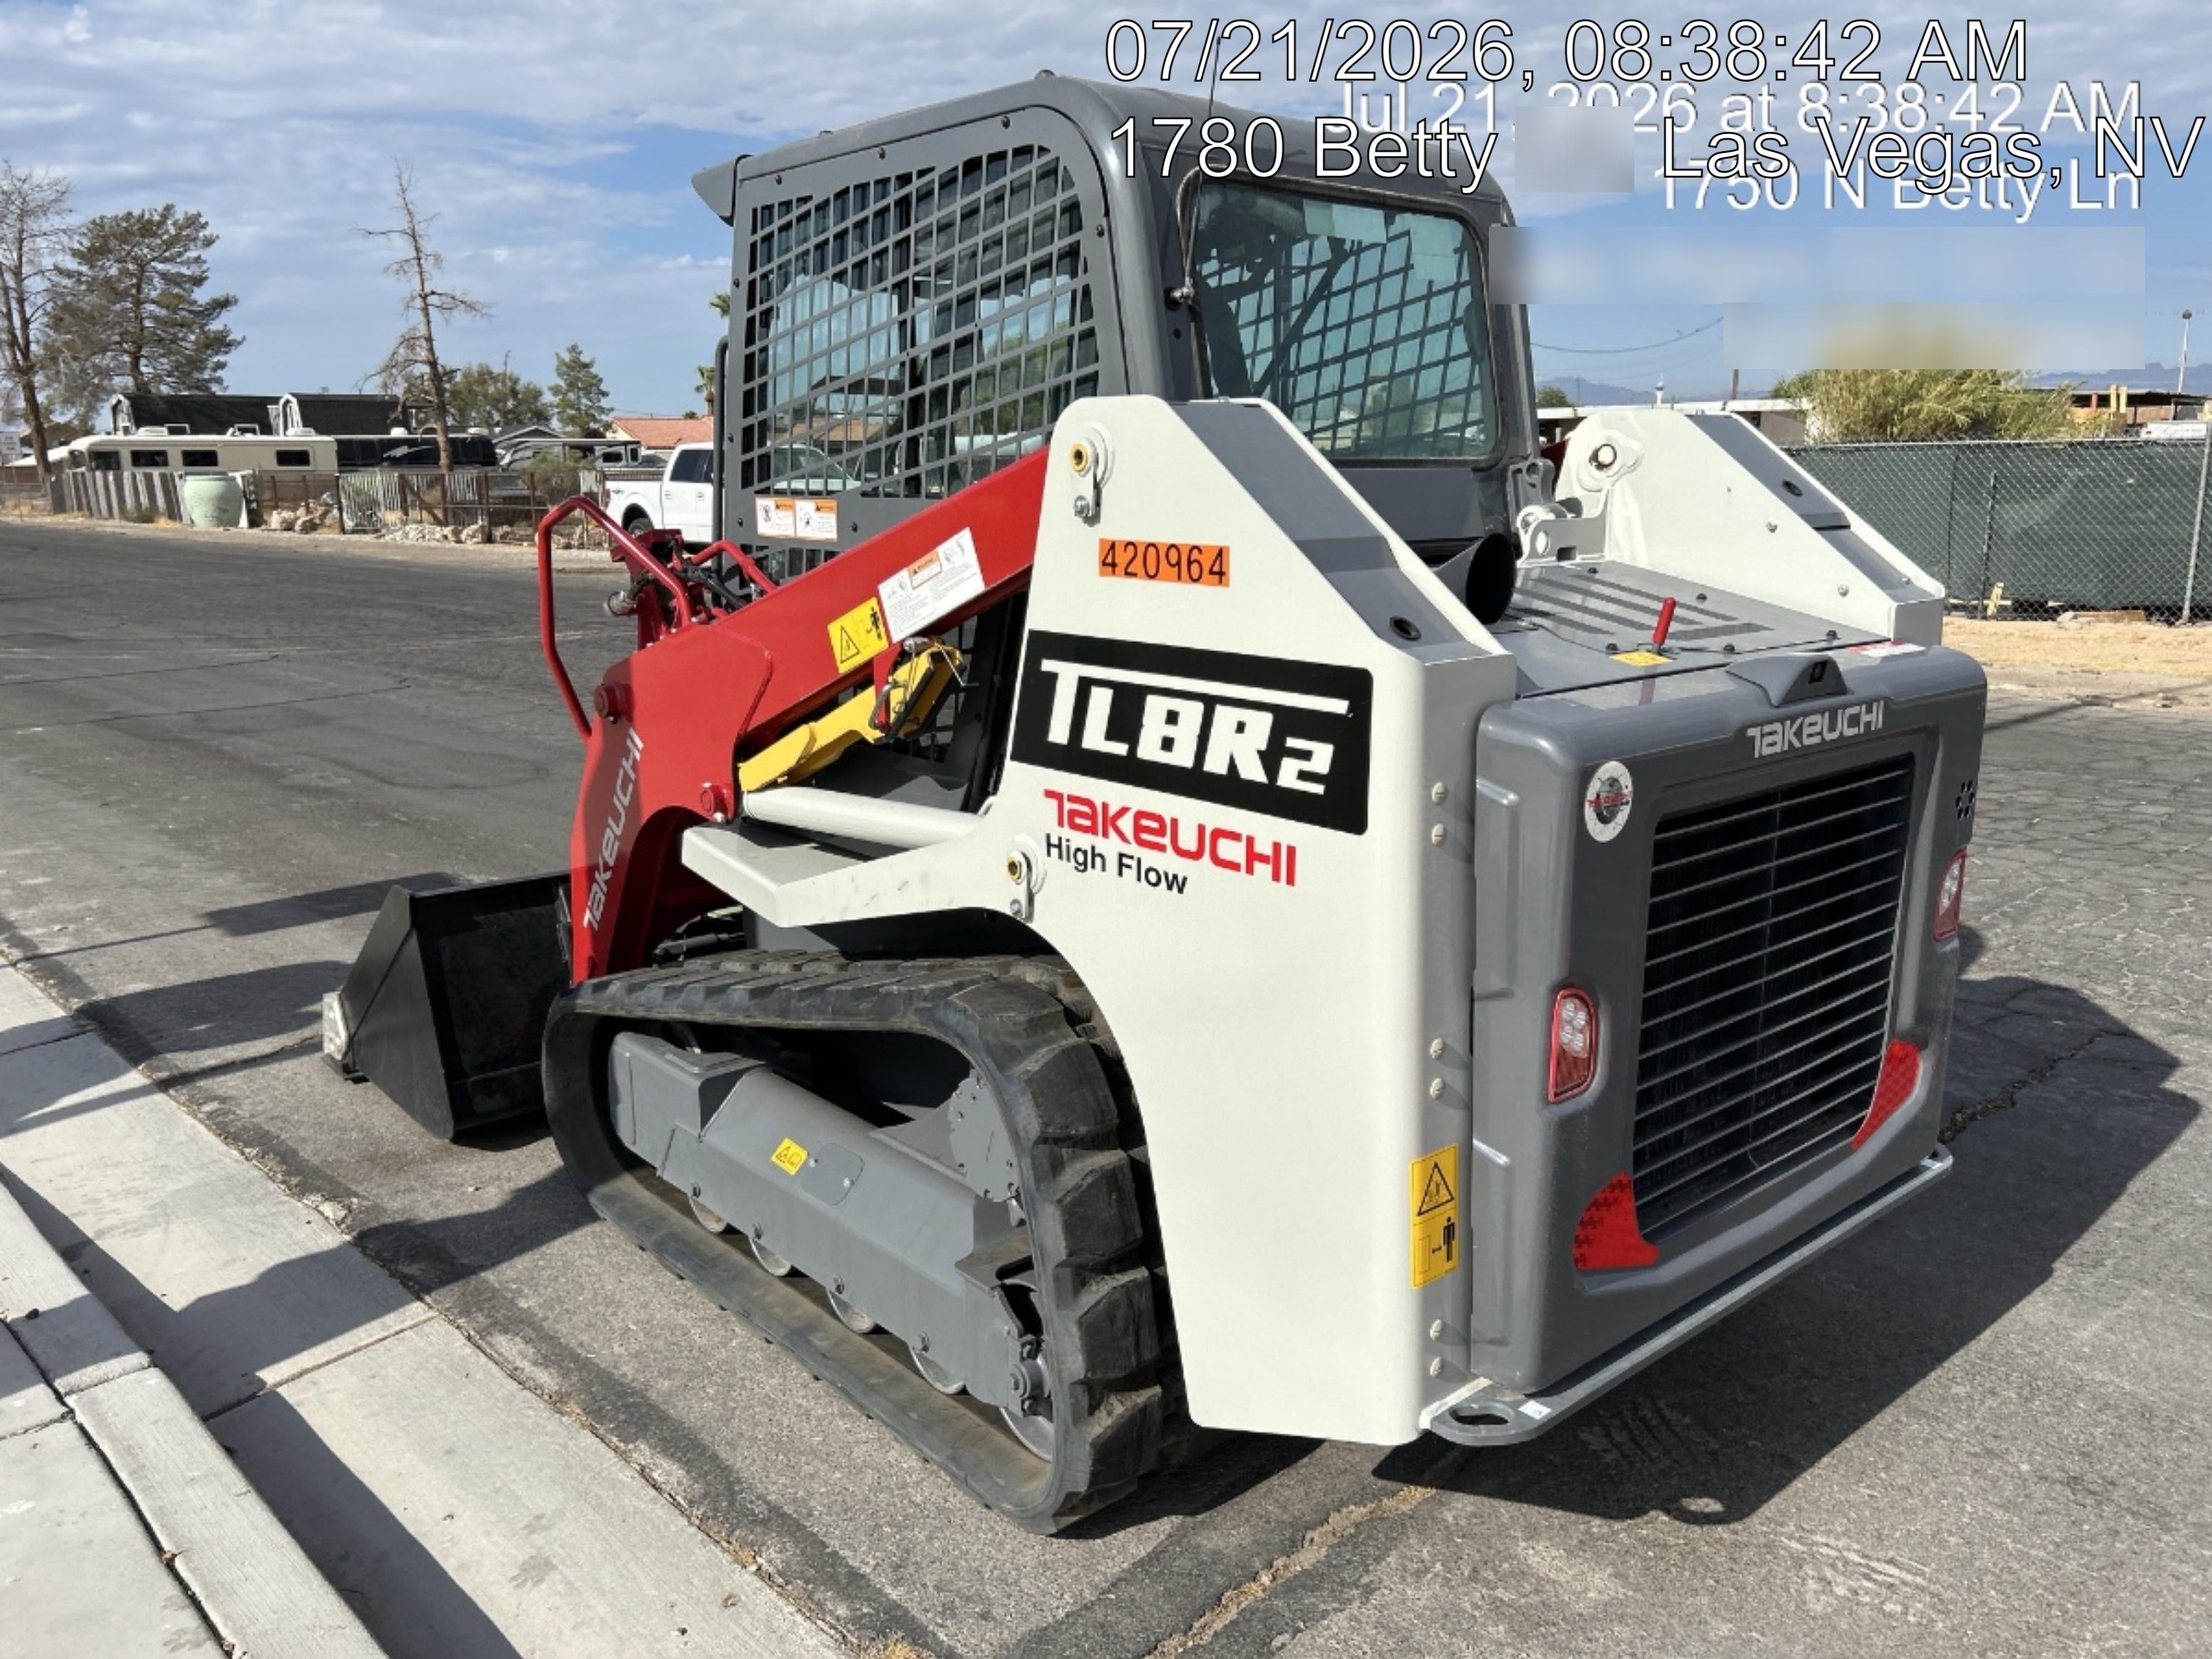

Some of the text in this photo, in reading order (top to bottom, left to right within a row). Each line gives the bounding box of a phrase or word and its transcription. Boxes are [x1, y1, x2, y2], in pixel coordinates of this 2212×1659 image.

[1101, 541, 1227, 585] 420964
[1041, 659, 1350, 795] TL8R2
[1045, 833, 1189, 895] High Flow
